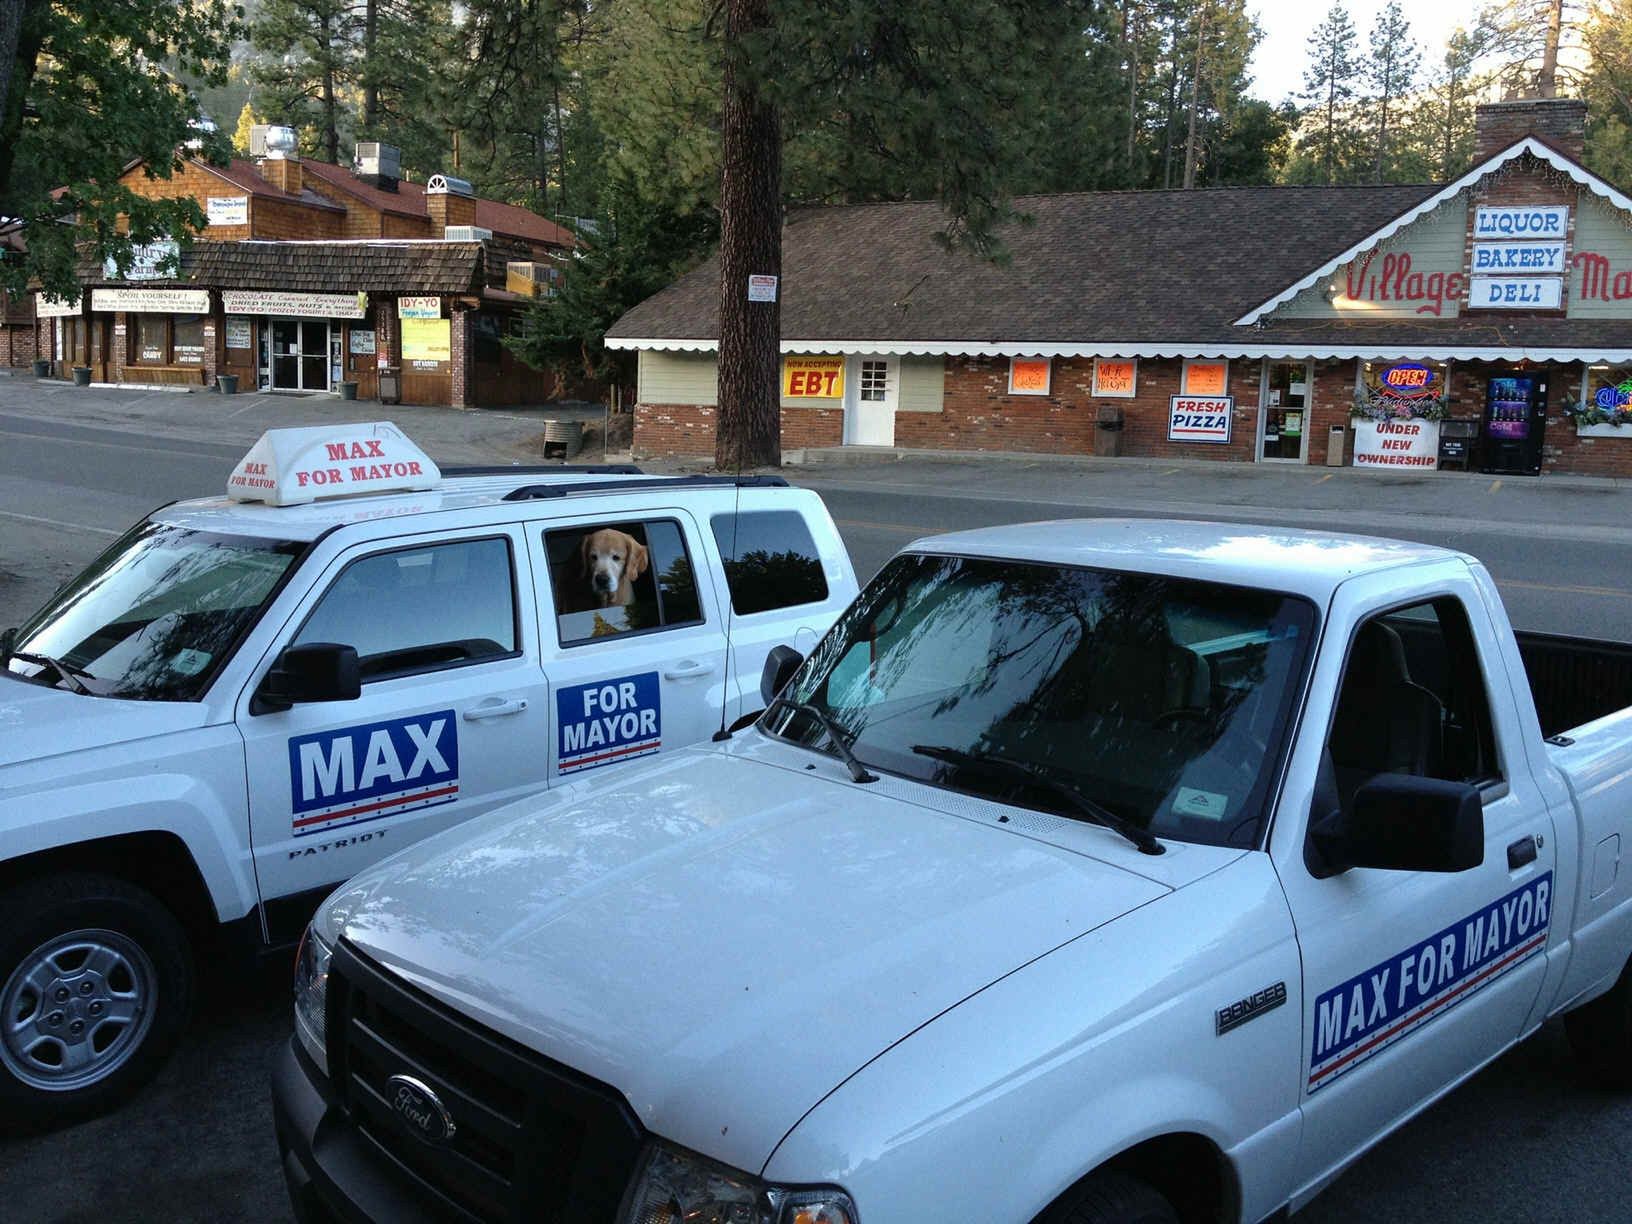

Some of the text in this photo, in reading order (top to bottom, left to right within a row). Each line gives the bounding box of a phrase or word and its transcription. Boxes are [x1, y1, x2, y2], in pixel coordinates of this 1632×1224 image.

[1478, 213, 1560, 234] LIQUOR
[1476, 248, 1560, 268] BAKERY
[1346, 249, 1465, 316] Village
[400, 298, 438, 307] IDY-YO
[1489, 284, 1541, 302] DELI
[787, 360, 842, 369] NOW ACCEPTING
[790, 371, 839, 396] EBT
[1388, 369, 1428, 386] OPEN
[1176, 401, 1227, 413] FRESH
[1173, 414, 1227, 429] PIZZA
[1376, 423, 1420, 435] UNDER
[325, 440, 385, 461] MAX
[1382, 439, 1412, 450] NEW
[244, 463, 268, 475] MAX
[1358, 454, 1435, 466] OWNERSHIP
[231, 476, 275, 489] FOR MAYOR
[296, 462, 423, 487] FOR MAYOR
[583, 682, 637, 717] FOR
[563, 708, 657, 752] MAYOR
[299, 719, 450, 801] MAX
[288, 828, 389, 860] PATRIOT
[1317, 880, 1550, 1056] MAX FOR MAYOR
[1218, 981, 1287, 1027] RANGER
[395, 1086, 432, 1131] Ford
